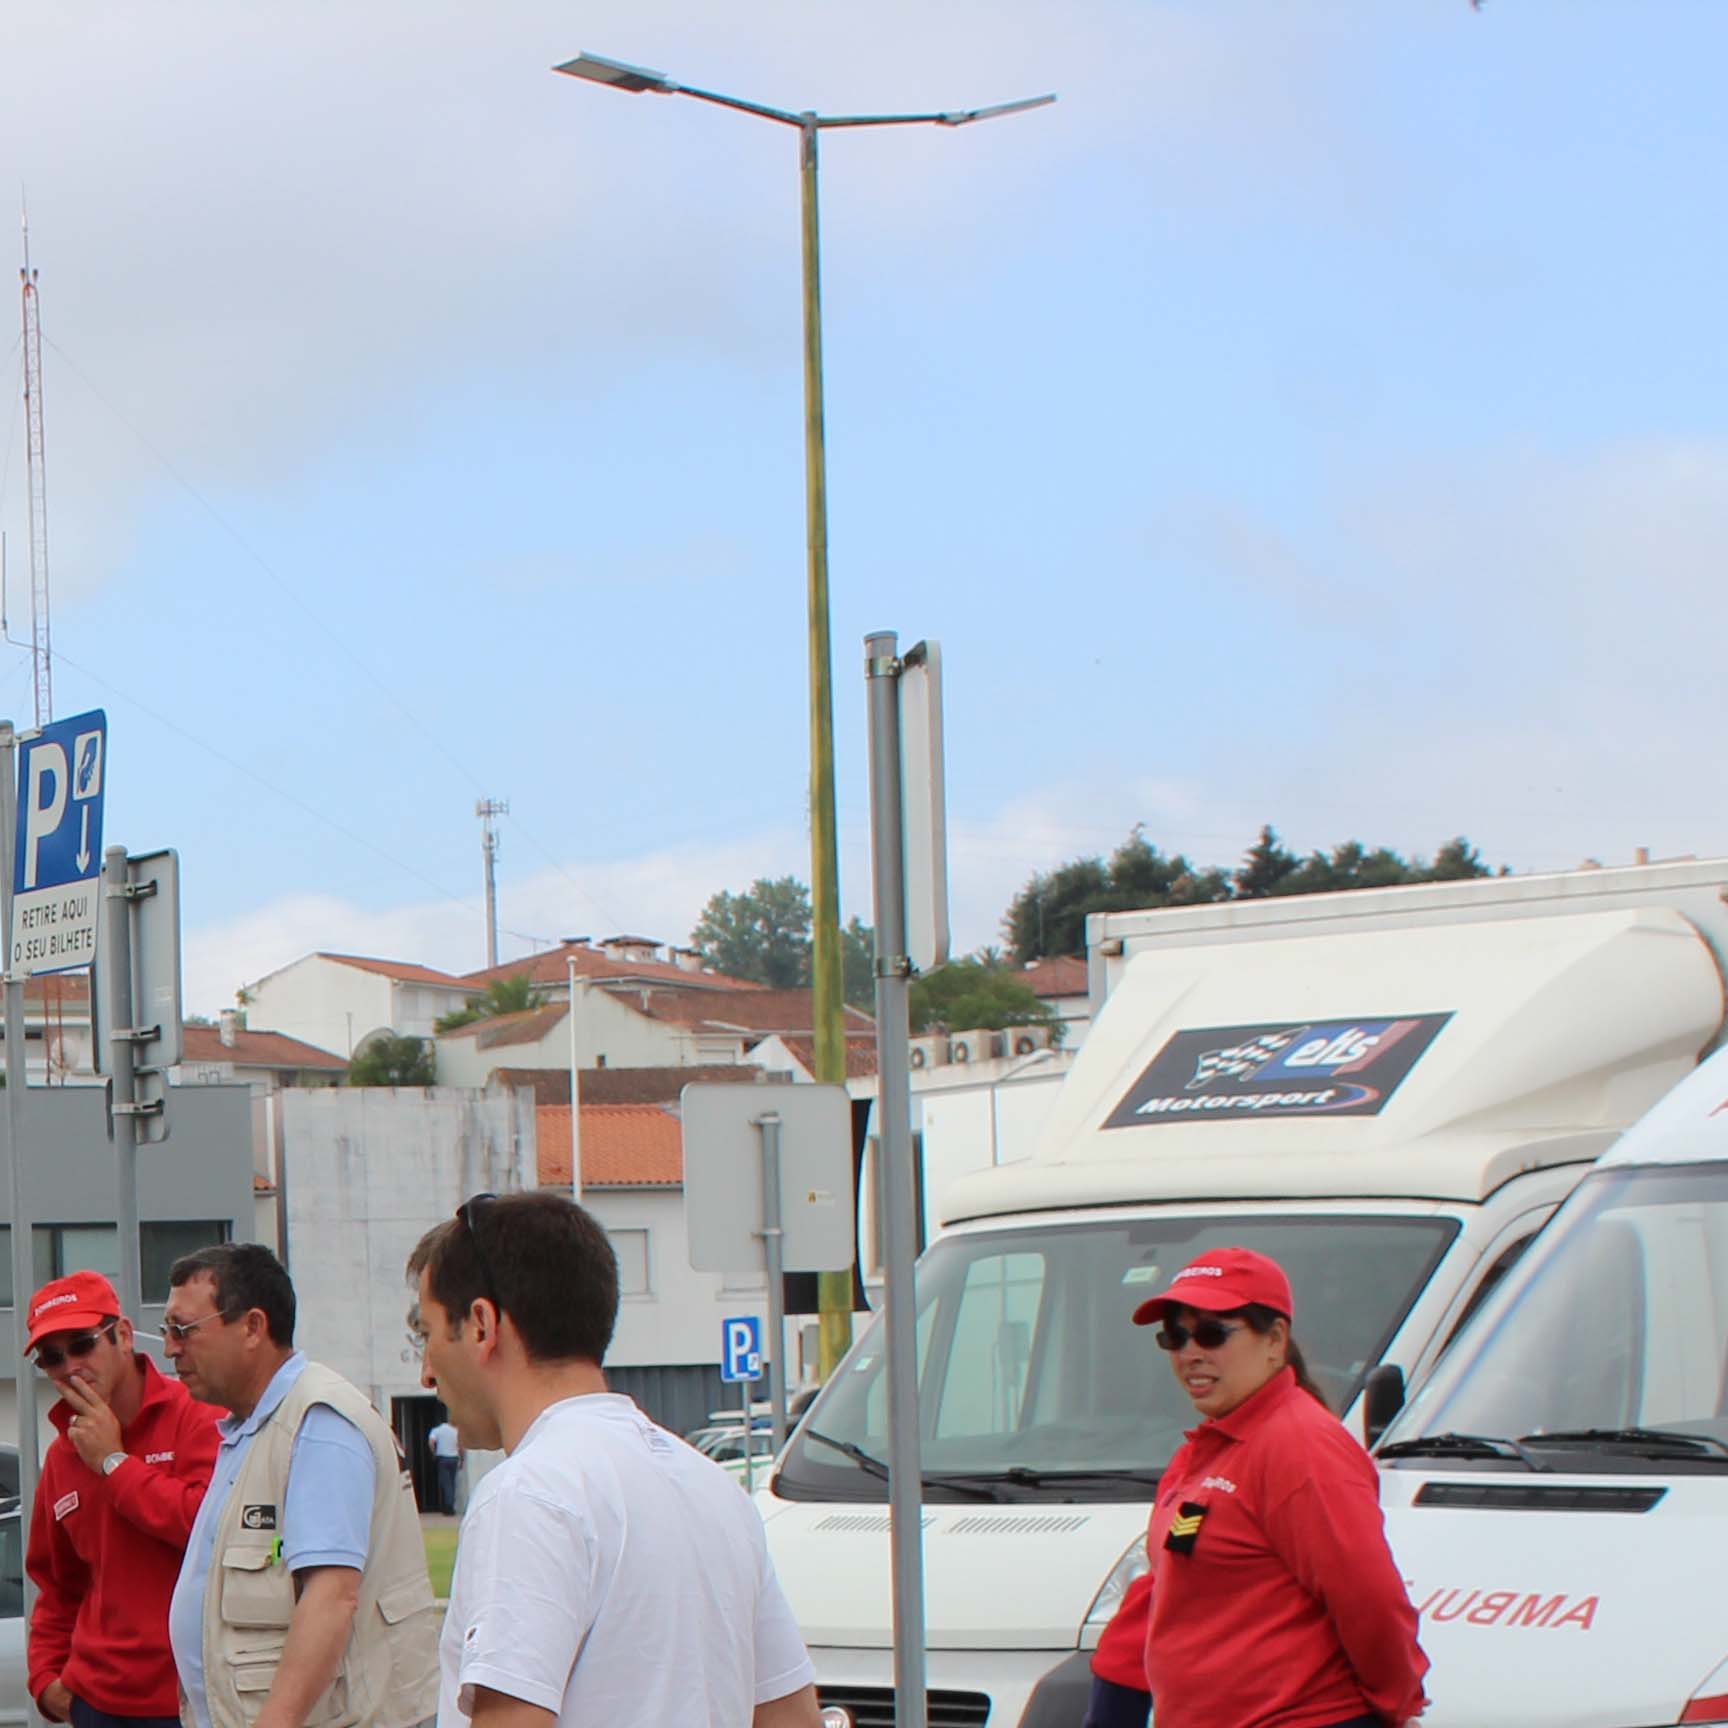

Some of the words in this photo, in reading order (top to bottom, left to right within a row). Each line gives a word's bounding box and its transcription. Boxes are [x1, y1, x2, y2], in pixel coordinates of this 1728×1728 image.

[24, 742, 69, 889] P
[21, 904, 57, 930] RETIRE
[61, 896, 88, 921] AQUI
[14, 943, 22, 963] O
[25, 933, 47, 961] SEU
[49, 928, 93, 955] BILHETE
[1135, 1087, 1337, 1115] Motorsport
